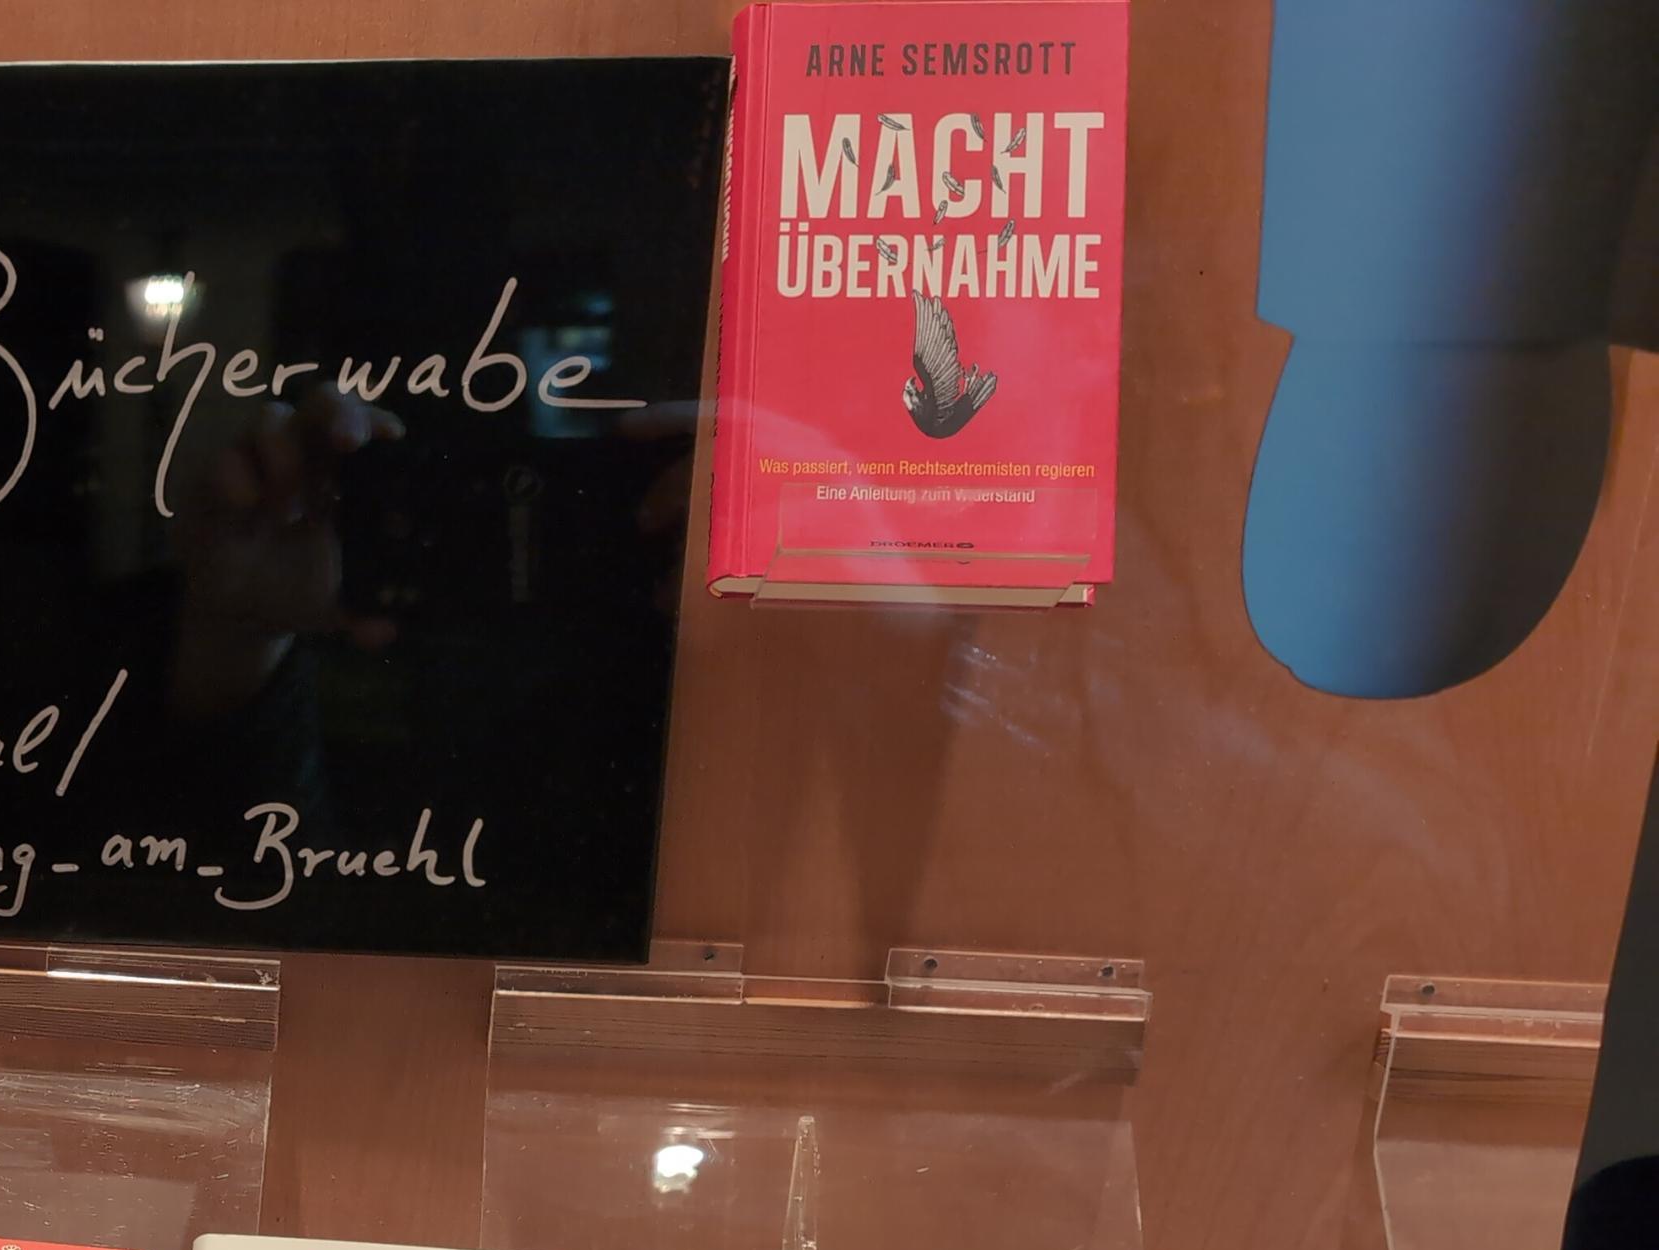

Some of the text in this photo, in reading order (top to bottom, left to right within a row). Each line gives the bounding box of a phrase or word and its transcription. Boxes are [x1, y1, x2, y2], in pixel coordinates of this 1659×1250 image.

[806, 42, 1076, 77] ARNE SEMSROTT
[780, 111, 1105, 219] MACHT
[777, 222, 1102, 299] ÜBERNAHME
[759, 459, 1095, 479] Was passiert, wenn Rechtsextremisten regieren
[817, 486, 847, 501] Eine
[851, 486, 917, 504] Anleitung
[921, 489, 951, 501] zum
